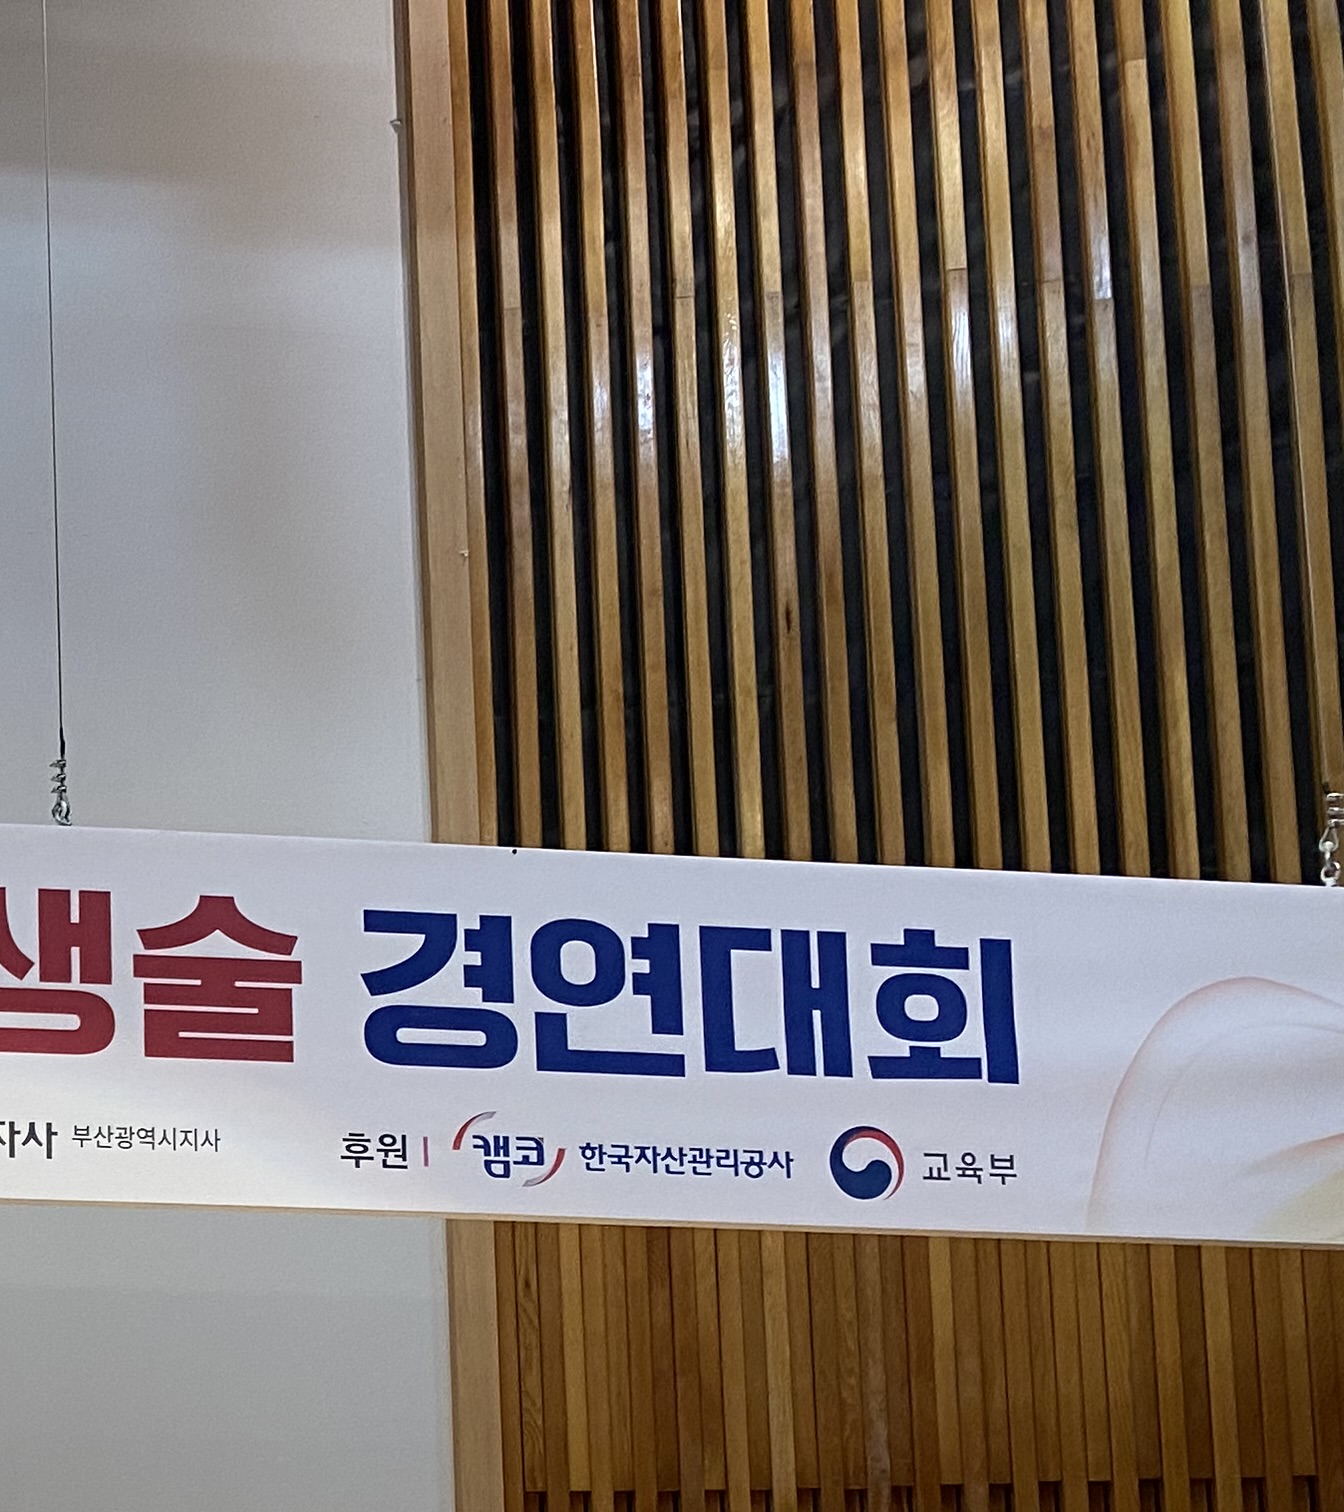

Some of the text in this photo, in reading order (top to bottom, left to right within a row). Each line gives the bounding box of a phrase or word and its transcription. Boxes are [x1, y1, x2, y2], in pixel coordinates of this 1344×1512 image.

[361, 910, 1019, 1084] 경연대회
[72, 1125, 220, 1152] 부산광역시지사
[341, 1133, 408, 1169] 후원
[472, 1135, 545, 1178] 캠코
[579, 1143, 794, 1178] 한국자산관리공사
[923, 1153, 1017, 1185] 교육부
